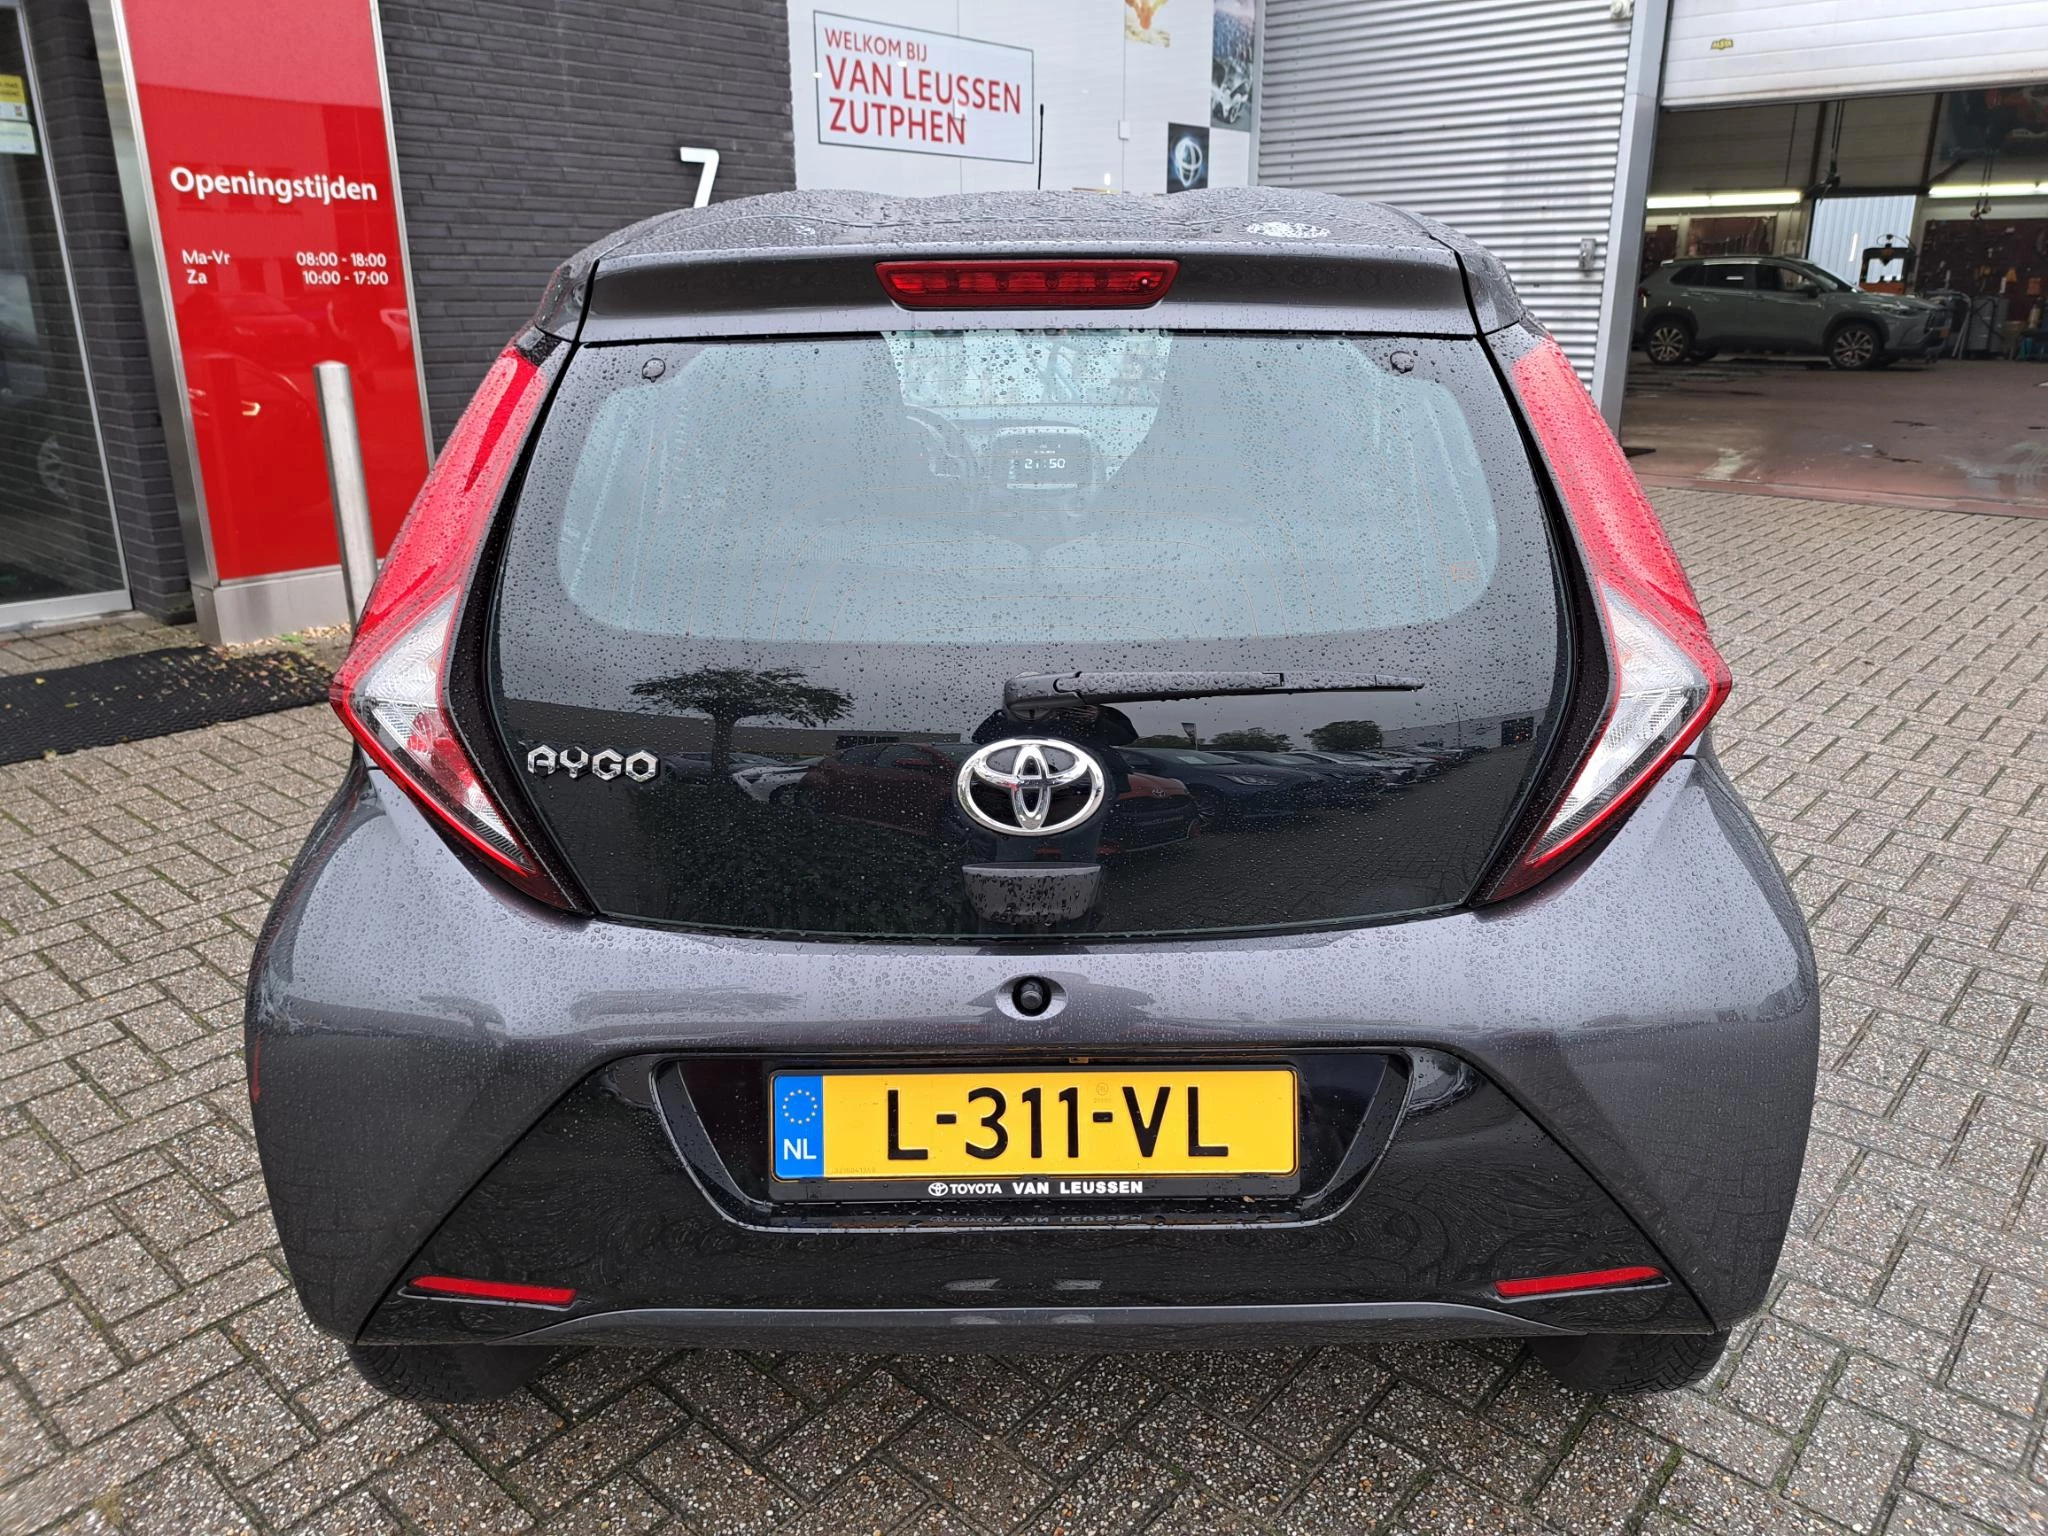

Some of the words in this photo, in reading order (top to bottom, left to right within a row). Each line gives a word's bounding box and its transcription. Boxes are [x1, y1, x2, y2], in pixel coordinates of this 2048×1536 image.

[824, 27, 901, 59] WELKOM
[906, 41, 928, 62] BIJ
[826, 55, 892, 97] VAN
[903, 66, 1020, 114] LEUSSEN
[829, 97, 965, 145] ZUTPHEN
[170, 166, 378, 205] Openingstijden
[680, 146, 719, 209] 7
[182, 250, 231, 265] Ma-Vr
[296, 252, 338, 267] 08:00
[350, 252, 387, 267] 18:00
[187, 269, 208, 285] Za
[303, 270, 341, 285] 10:00
[353, 271, 389, 285] 17:00
[527, 744, 658, 782] AYGO
[887, 1086, 1229, 1160] L-311-VL
[783, 1138, 817, 1160] NL
[950, 1183, 1003, 1195] TOYOTA
[1012, 1182, 1049, 1195] VAN
[1060, 1181, 1143, 1194] LEUSSEN
